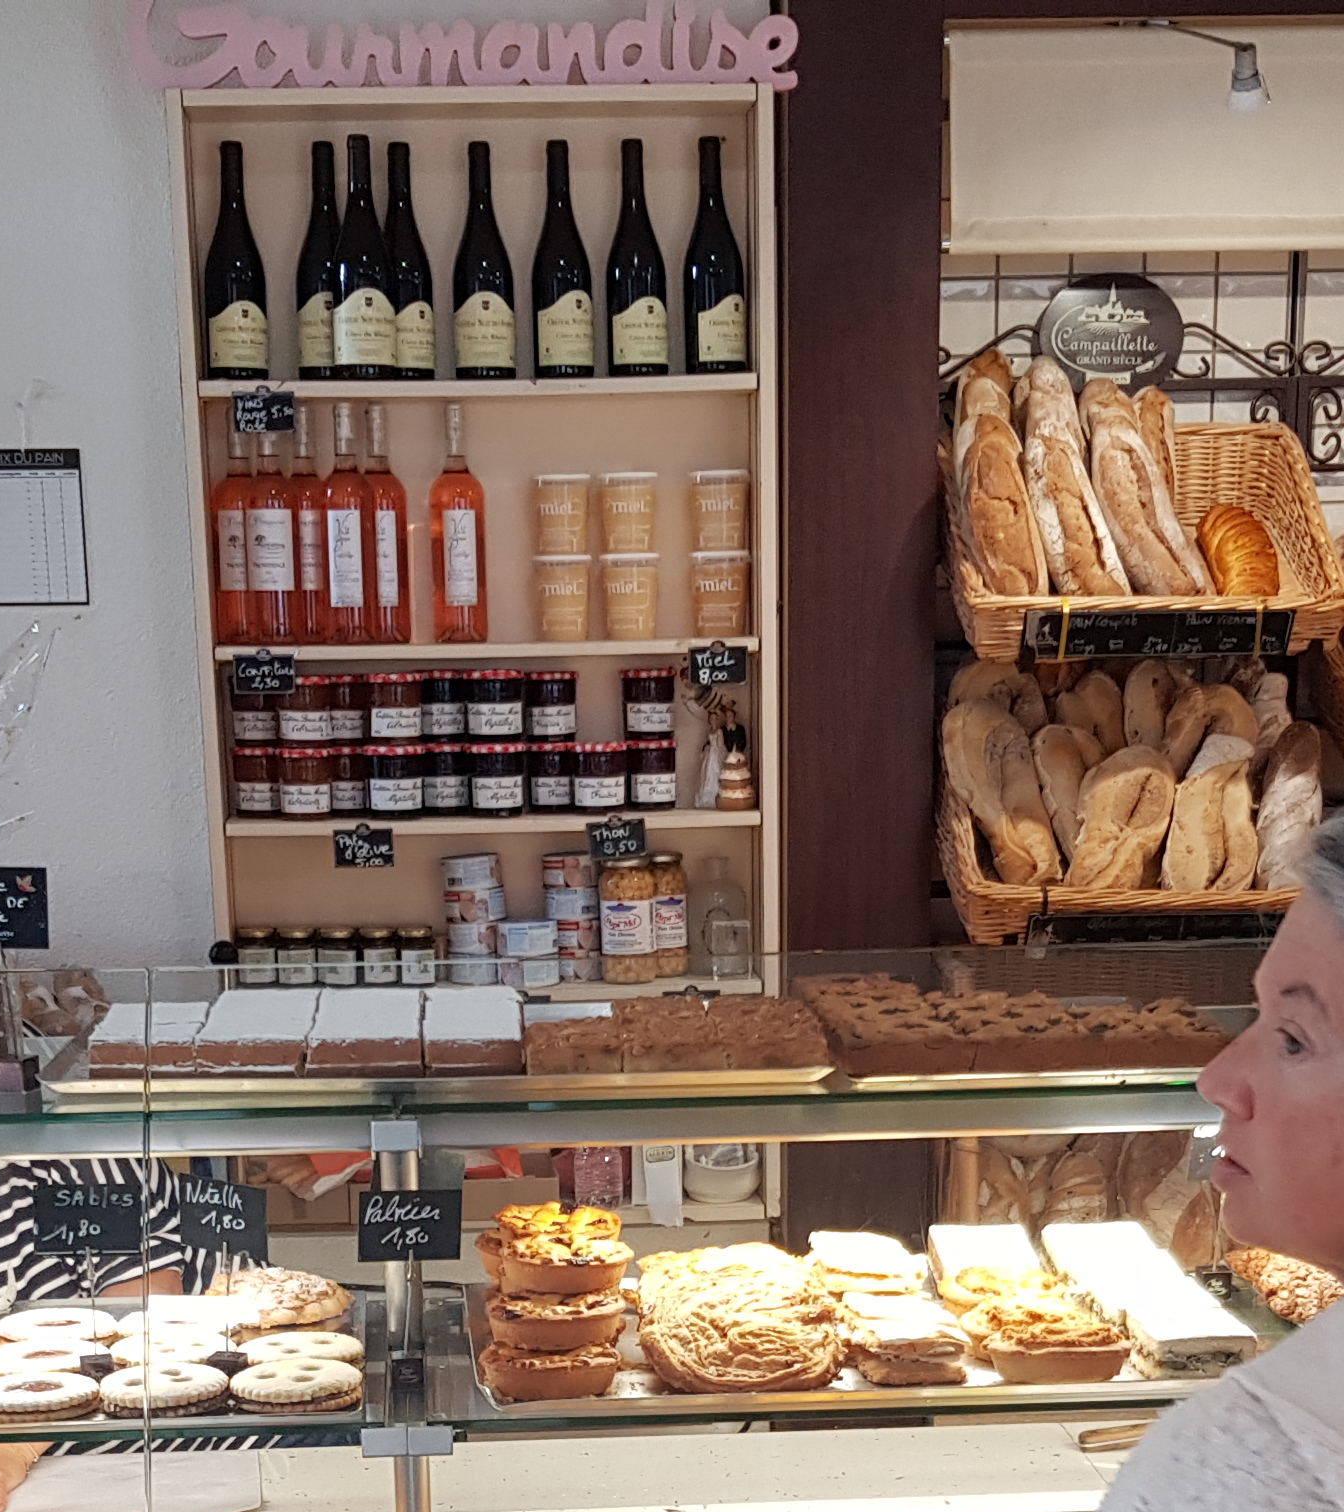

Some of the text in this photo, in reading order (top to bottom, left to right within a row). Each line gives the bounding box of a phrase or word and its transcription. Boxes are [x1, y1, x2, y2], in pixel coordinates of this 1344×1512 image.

[132, 0, 798, 92] Gourmandise
[1057, 327, 1158, 355] Campaillette
[1076, 355, 1111, 365] GRAND
[13, 453, 32, 464] DU
[35, 452, 64, 464] PAIN
[41, 1219, 101, 1246] 1,80
[201, 1211, 246, 1234] 1,80
[381, 1226, 429, 1250] 1,80
